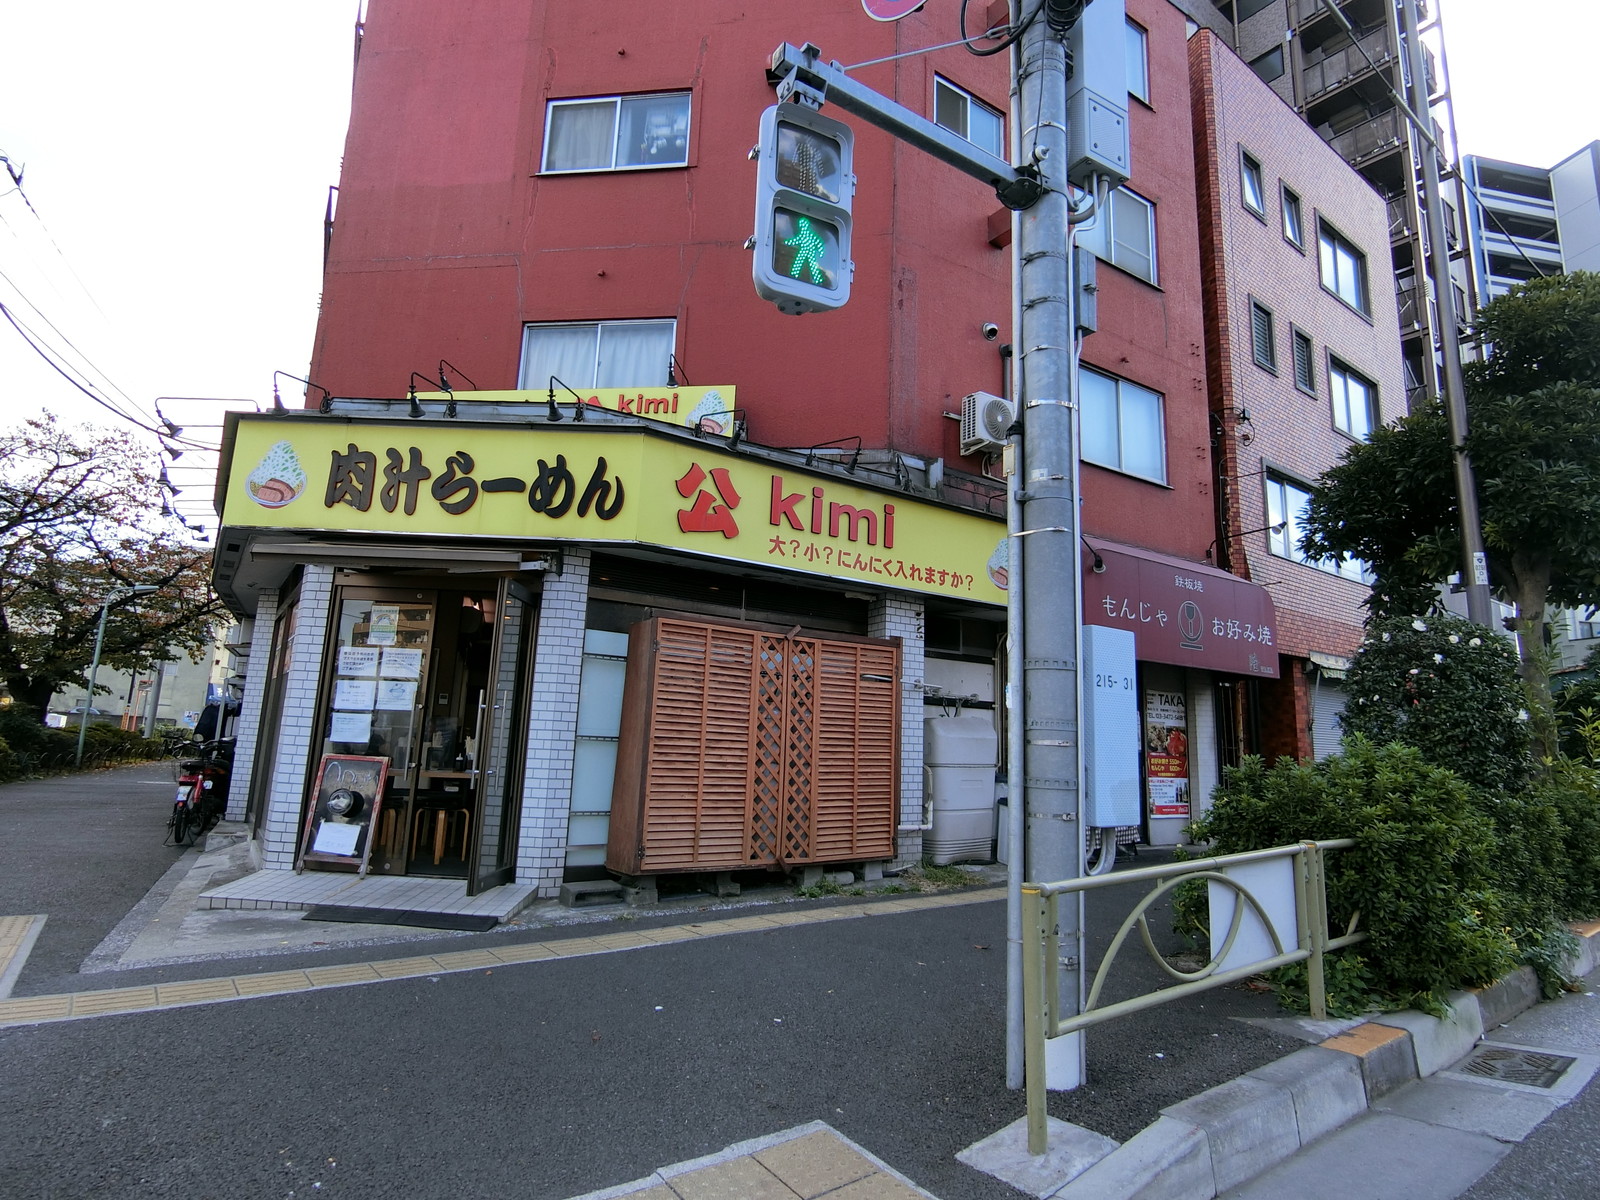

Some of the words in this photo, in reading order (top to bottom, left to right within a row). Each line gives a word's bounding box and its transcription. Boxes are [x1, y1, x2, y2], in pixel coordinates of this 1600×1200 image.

[618, 393, 679, 414] kimi
[325, 443, 624, 517] 肉汁らーめん
[676, 463, 740, 539] 公
[770, 475, 895, 549] kimi
[1174, 575, 1204, 593] 鉄板焼
[1102, 594, 1168, 627] もんじゃ
[1212, 616, 1273, 646] お好み焼
[1158, 694, 1185, 708] TAKA
